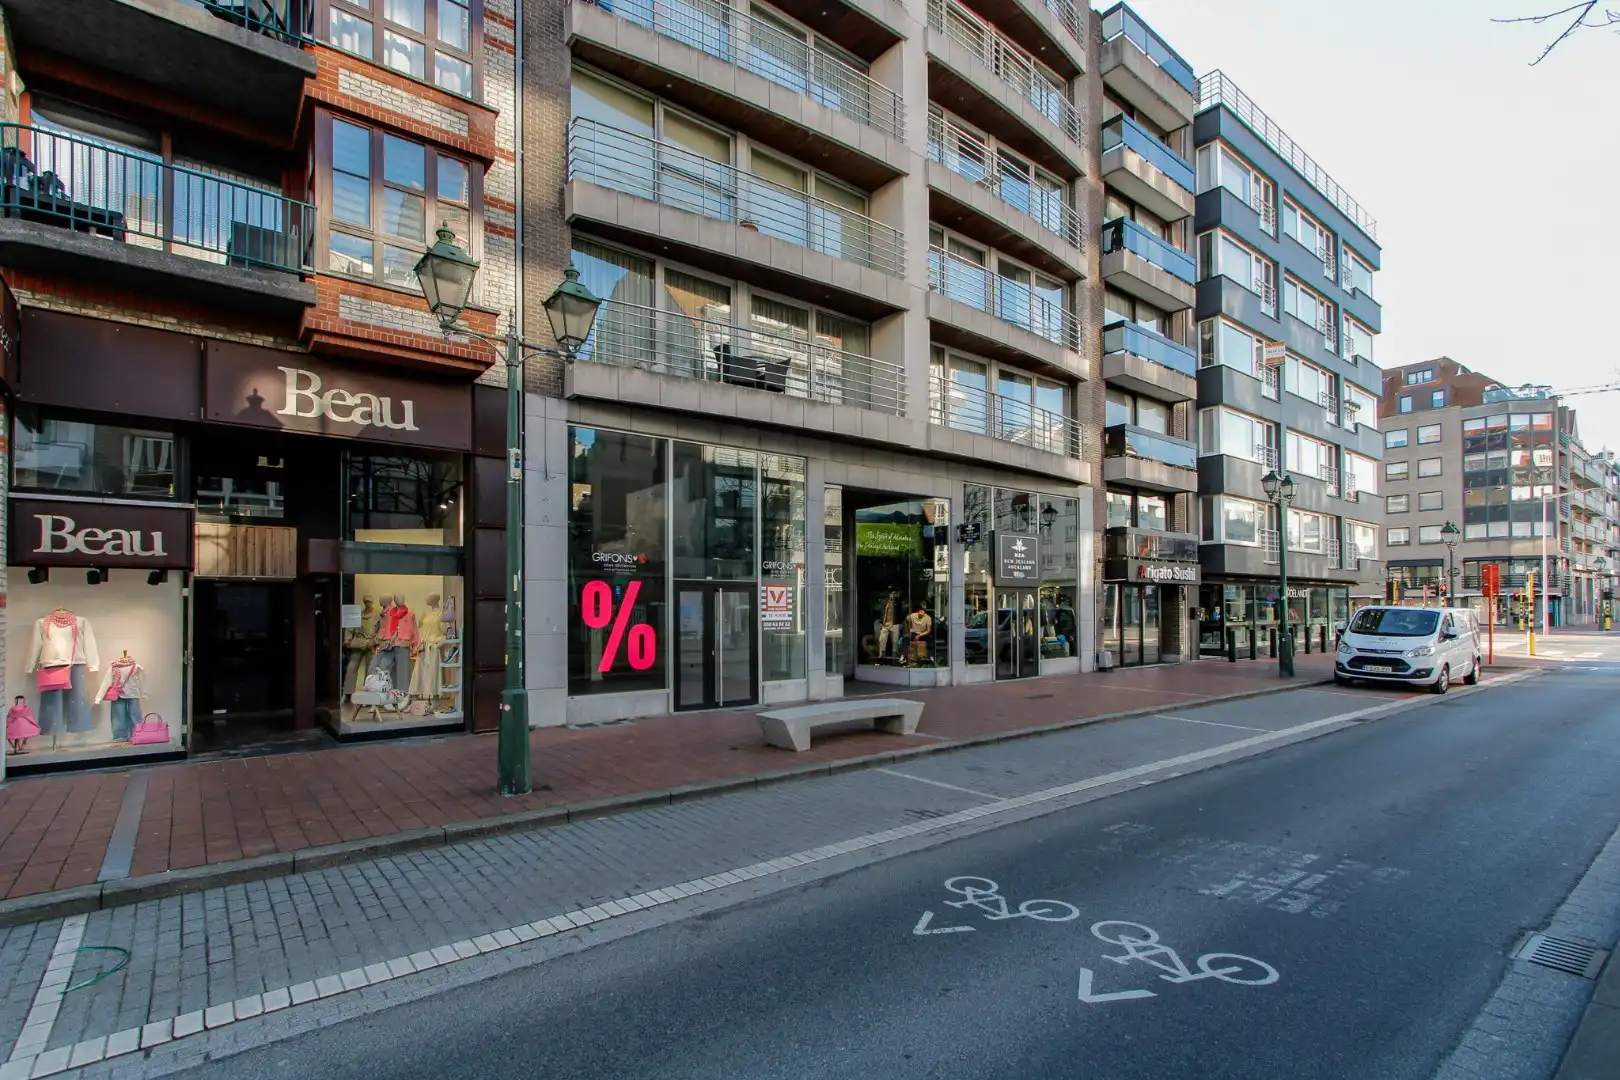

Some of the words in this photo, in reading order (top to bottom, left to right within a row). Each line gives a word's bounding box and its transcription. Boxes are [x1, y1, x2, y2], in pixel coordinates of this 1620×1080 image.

[277, 366, 419, 431] Beau
[33, 514, 168, 557] Beau
[592, 552, 633, 563] GRIFONS
[762, 560, 793, 570] GRIFONS
[1138, 564, 1172, 582] Arigato
[1174, 566, 1196, 581] Sushi
[582, 580, 656, 673] %
